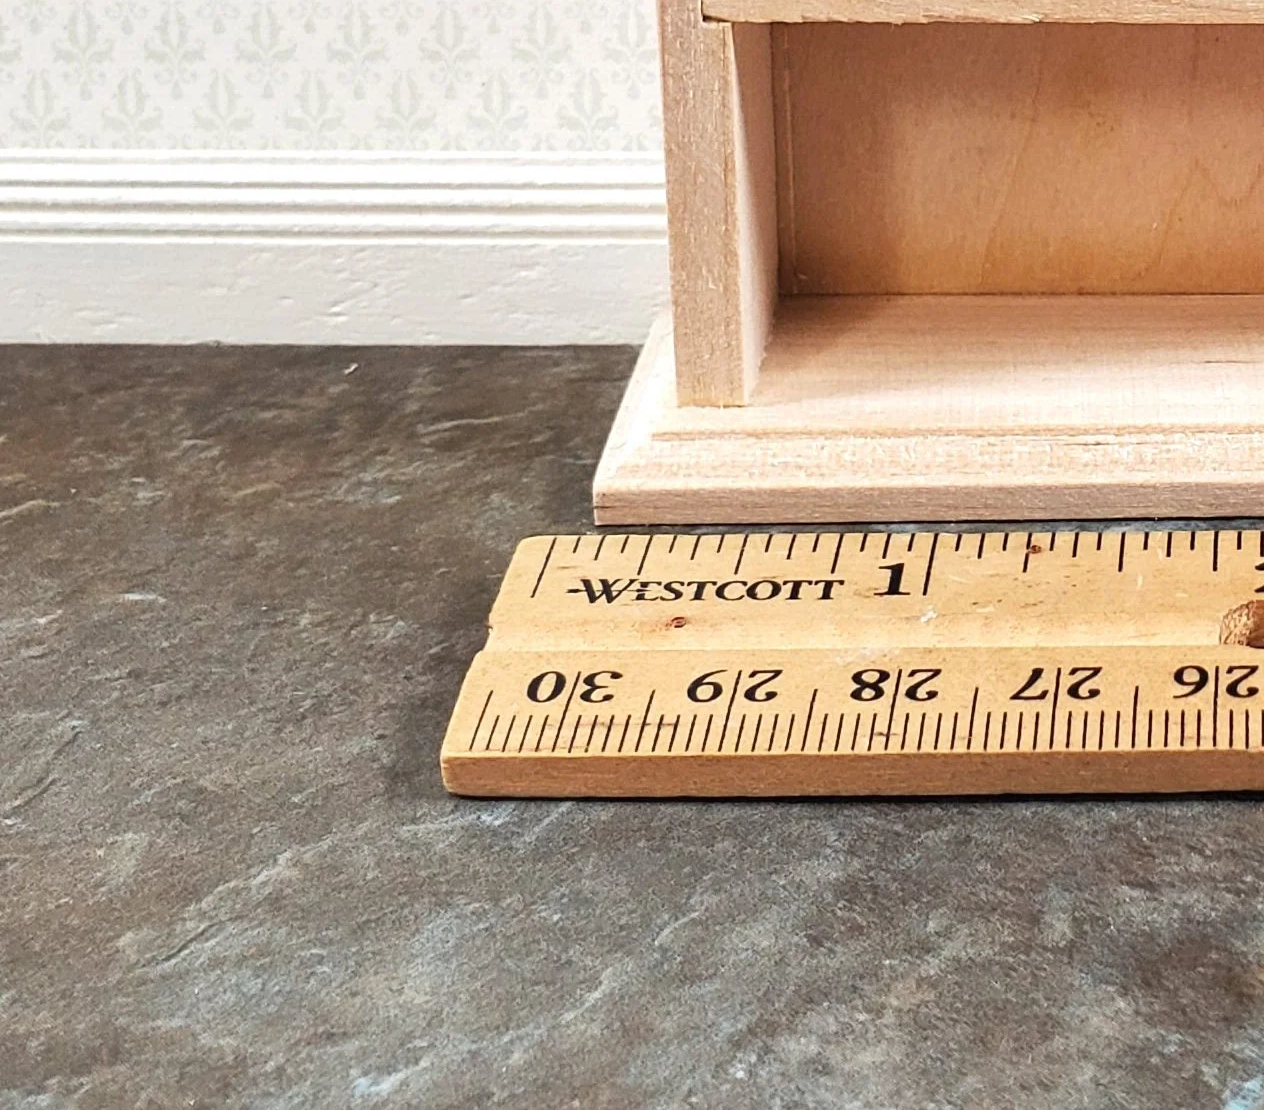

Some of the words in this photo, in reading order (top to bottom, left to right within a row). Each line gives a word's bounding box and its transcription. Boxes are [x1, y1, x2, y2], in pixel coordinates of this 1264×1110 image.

[566, 578, 845, 604] WESTCOTT
[873, 562, 911, 597] 1
[526, 670, 623, 704] 30
[686, 669, 783, 703] 29
[849, 668, 943, 702] 28
[1009, 667, 1103, 700] 27
[1172, 665, 1260, 699] 26
